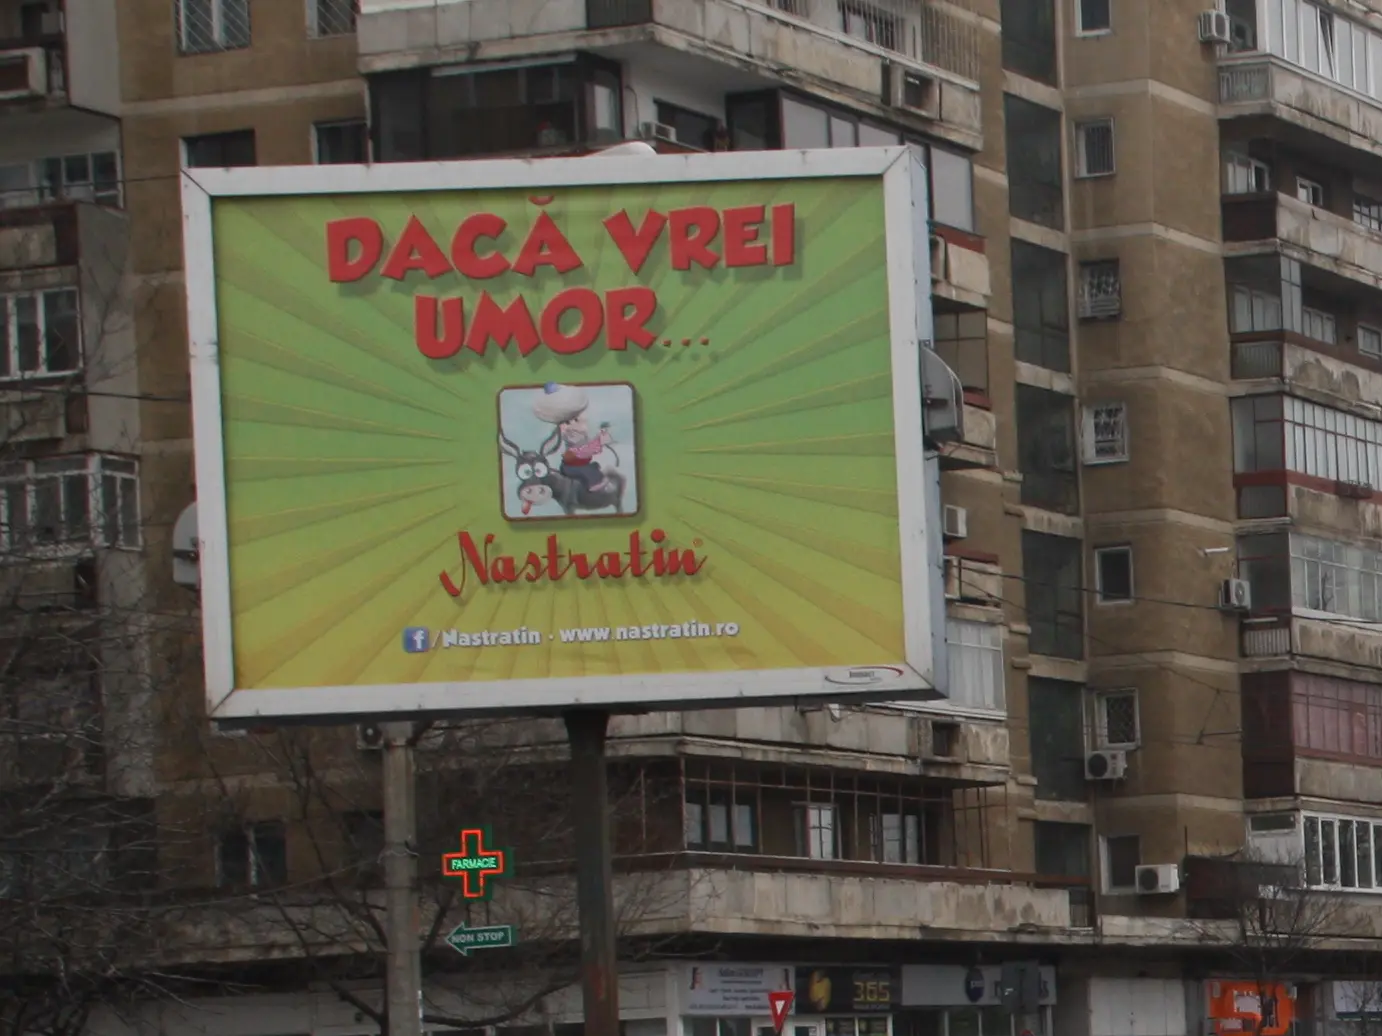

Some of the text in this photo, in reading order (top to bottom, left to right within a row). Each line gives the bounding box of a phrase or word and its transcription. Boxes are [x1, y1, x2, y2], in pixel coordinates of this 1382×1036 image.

[325, 195, 796, 283] DACĂ VREI
[414, 287, 711, 359] UMOR...
[438, 528, 707, 598] Nastratin
[559, 619, 740, 643] www.nastratin.ro
[451, 857, 497, 870] FARMACIE
[451, 931, 505, 943] NON STOP
[853, 981, 890, 1002] 365
